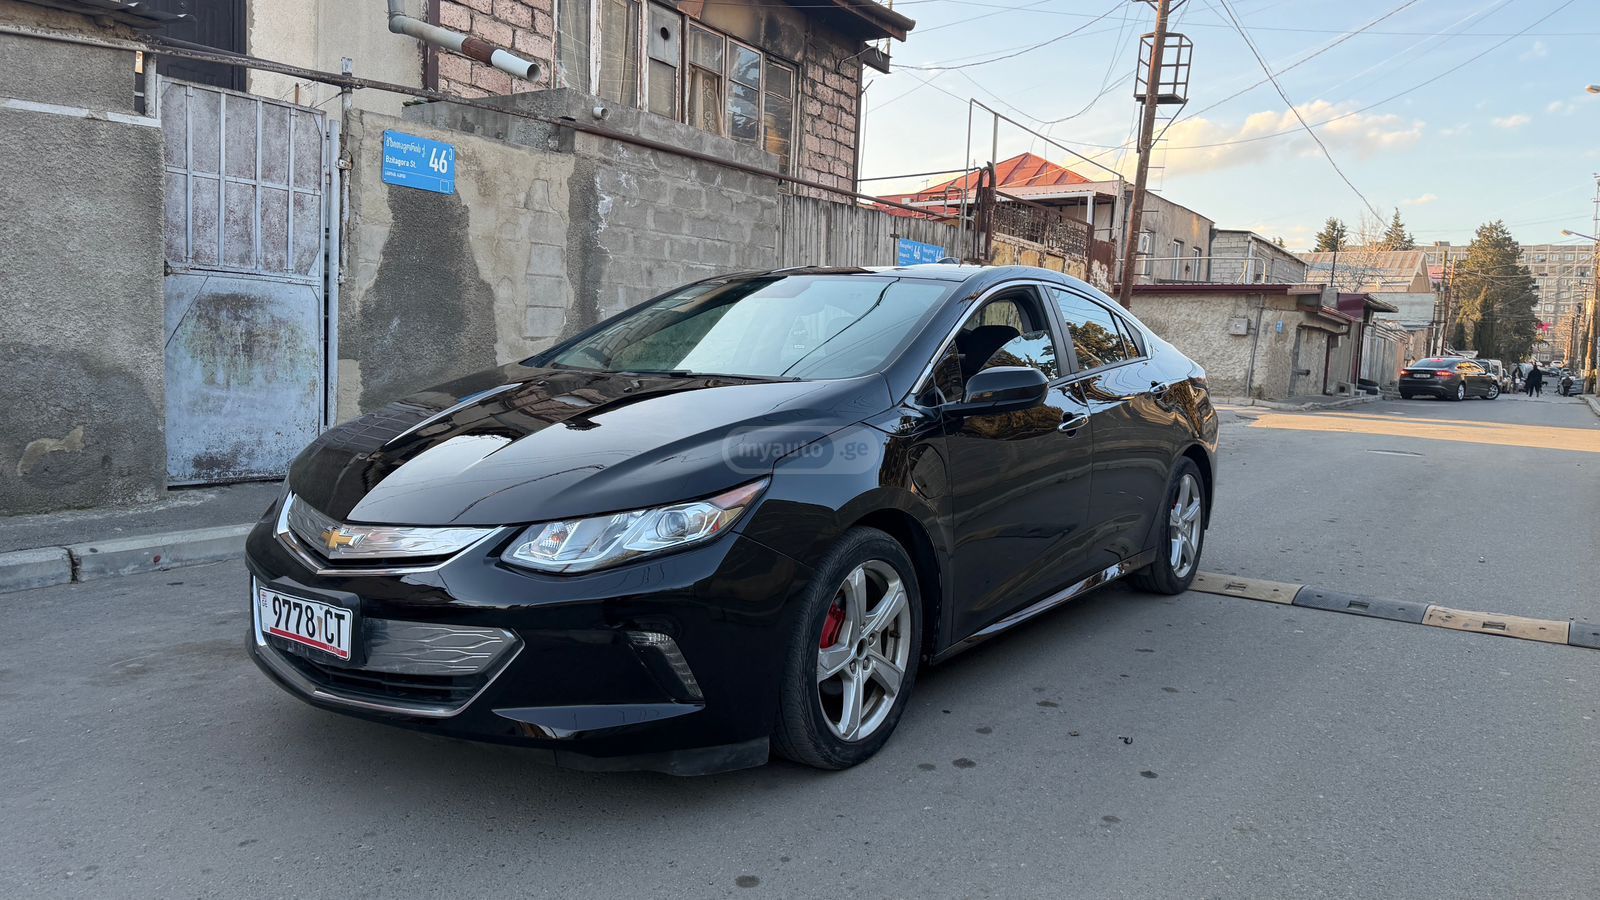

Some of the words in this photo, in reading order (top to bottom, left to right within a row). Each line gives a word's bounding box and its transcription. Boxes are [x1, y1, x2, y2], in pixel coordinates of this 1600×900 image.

[429, 148, 448, 174] 46
[272, 594, 316, 638] 9778
[324, 607, 346, 649] CT
